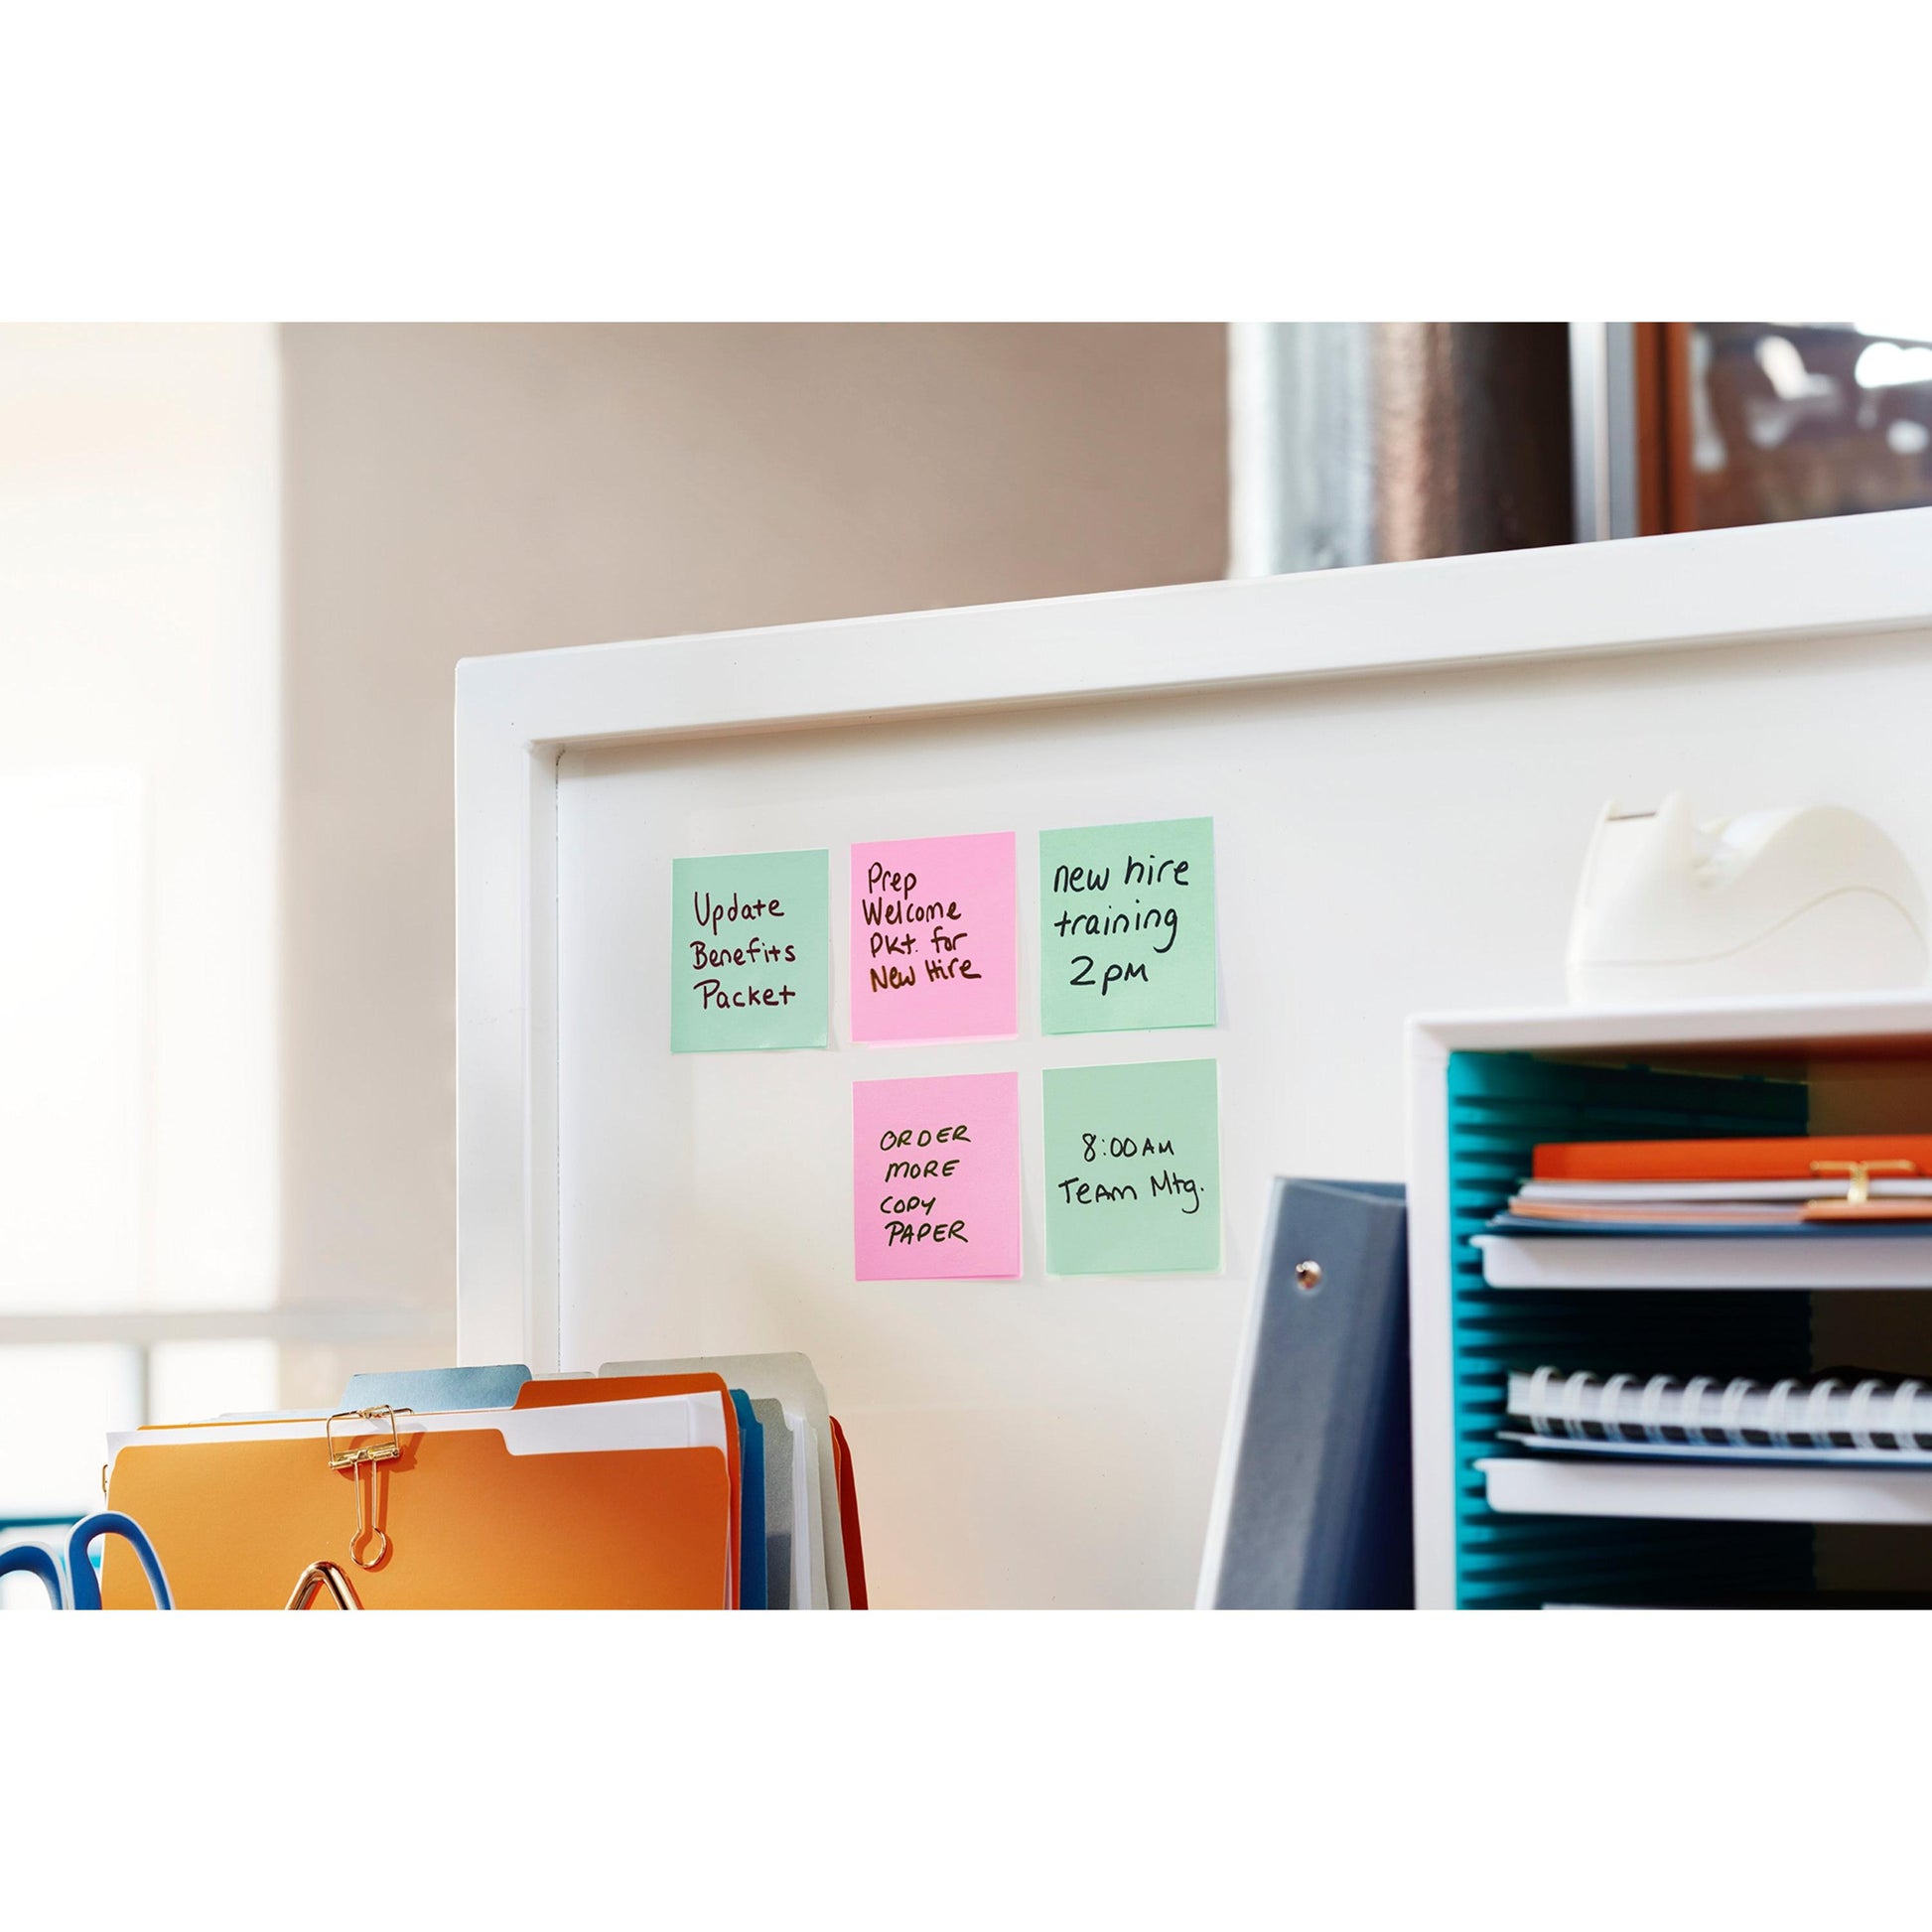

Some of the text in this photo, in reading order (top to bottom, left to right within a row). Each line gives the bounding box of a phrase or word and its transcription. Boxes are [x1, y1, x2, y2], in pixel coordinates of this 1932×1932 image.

[868, 861, 917, 901] Prep
[1053, 854, 1189, 893] new hire
[694, 891, 785, 936] Update
[862, 896, 962, 926] Welcome
[1053, 898, 1178, 954] training
[689, 936, 796, 971] Benefits
[930, 925, 968, 954] for
[870, 957, 983, 993] New Hire
[693, 978, 796, 1010] Packet
[880, 1124, 972, 1152] ORDER
[884, 1159, 961, 1183] MORE
[880, 1195, 936, 1216] COPY
[1150, 1170, 1204, 1214] Mtg.
[884, 1219, 969, 1247] PAPER
